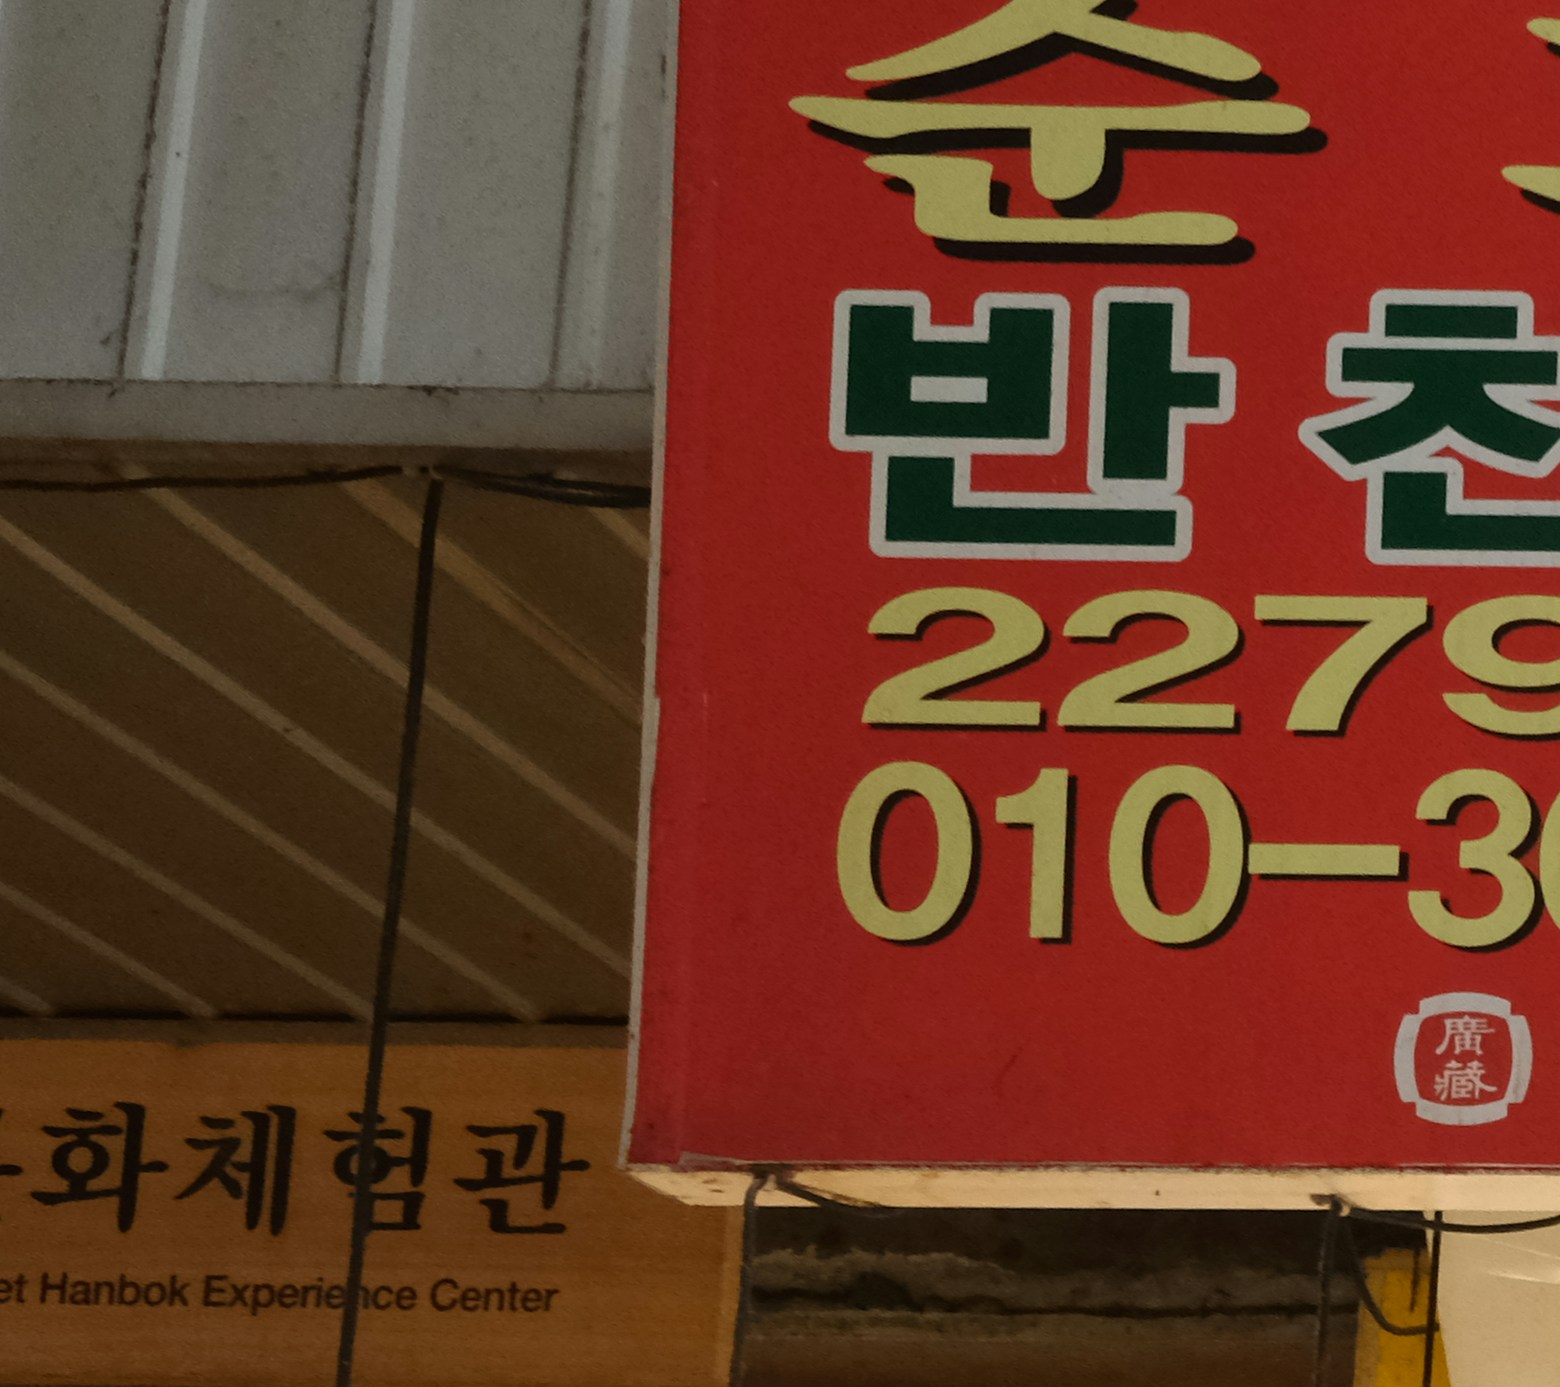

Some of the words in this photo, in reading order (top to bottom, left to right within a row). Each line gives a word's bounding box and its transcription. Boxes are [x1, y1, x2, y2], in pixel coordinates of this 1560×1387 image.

[40, 1271, 190, 1309] Hanbok
[203, 1275, 414, 1313] Experience
[429, 1278, 559, 1314] Center
